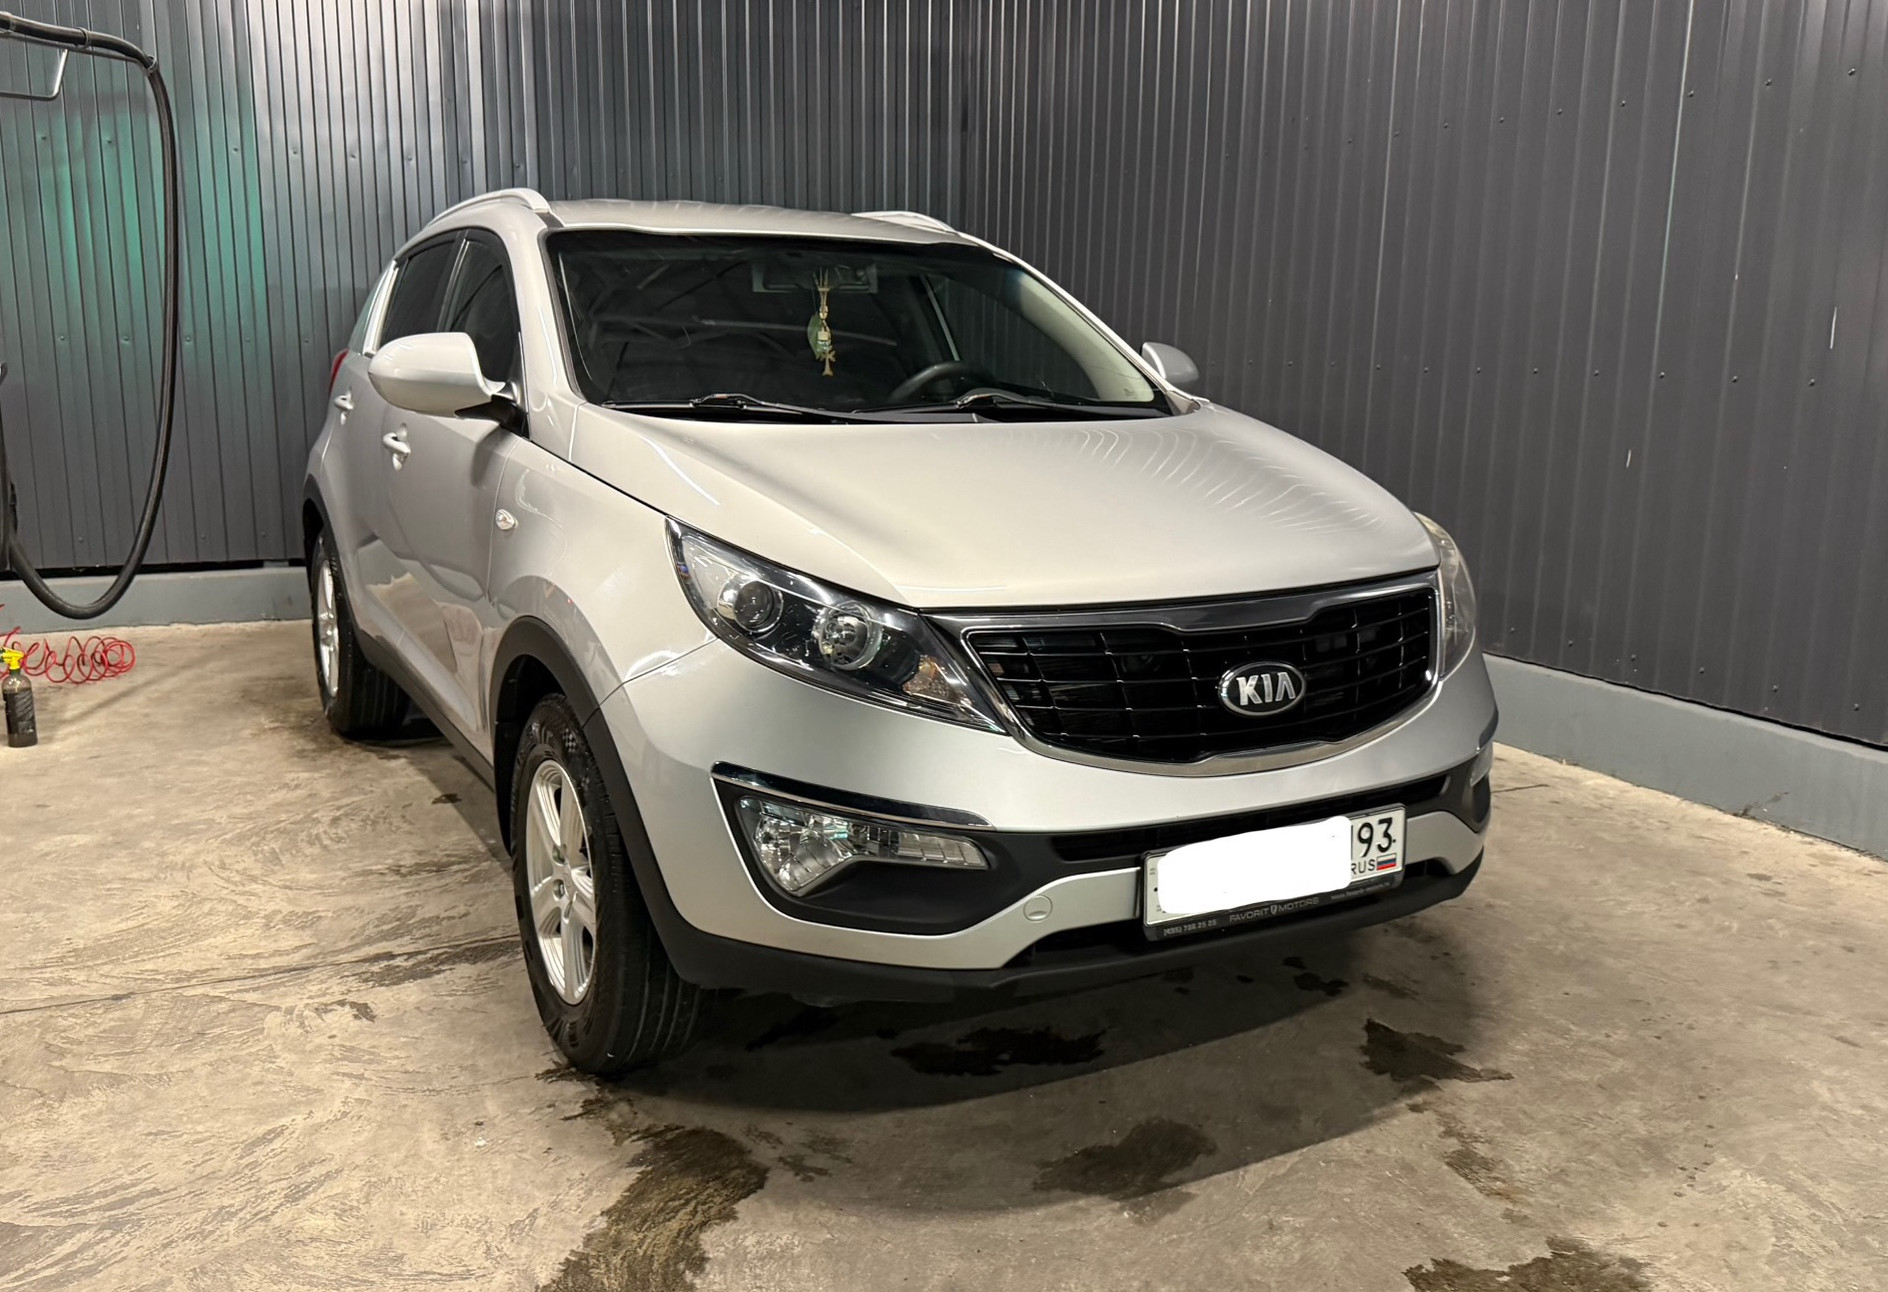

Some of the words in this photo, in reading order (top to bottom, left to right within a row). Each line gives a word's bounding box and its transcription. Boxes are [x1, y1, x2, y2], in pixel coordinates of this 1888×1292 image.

[1236, 671, 1296, 706] KIA
[1357, 816, 1393, 858] 93
[1351, 858, 1376, 875] RUS
[1229, 906, 1270, 922] FAVORIT
[1278, 897, 1320, 912] MOTORS
